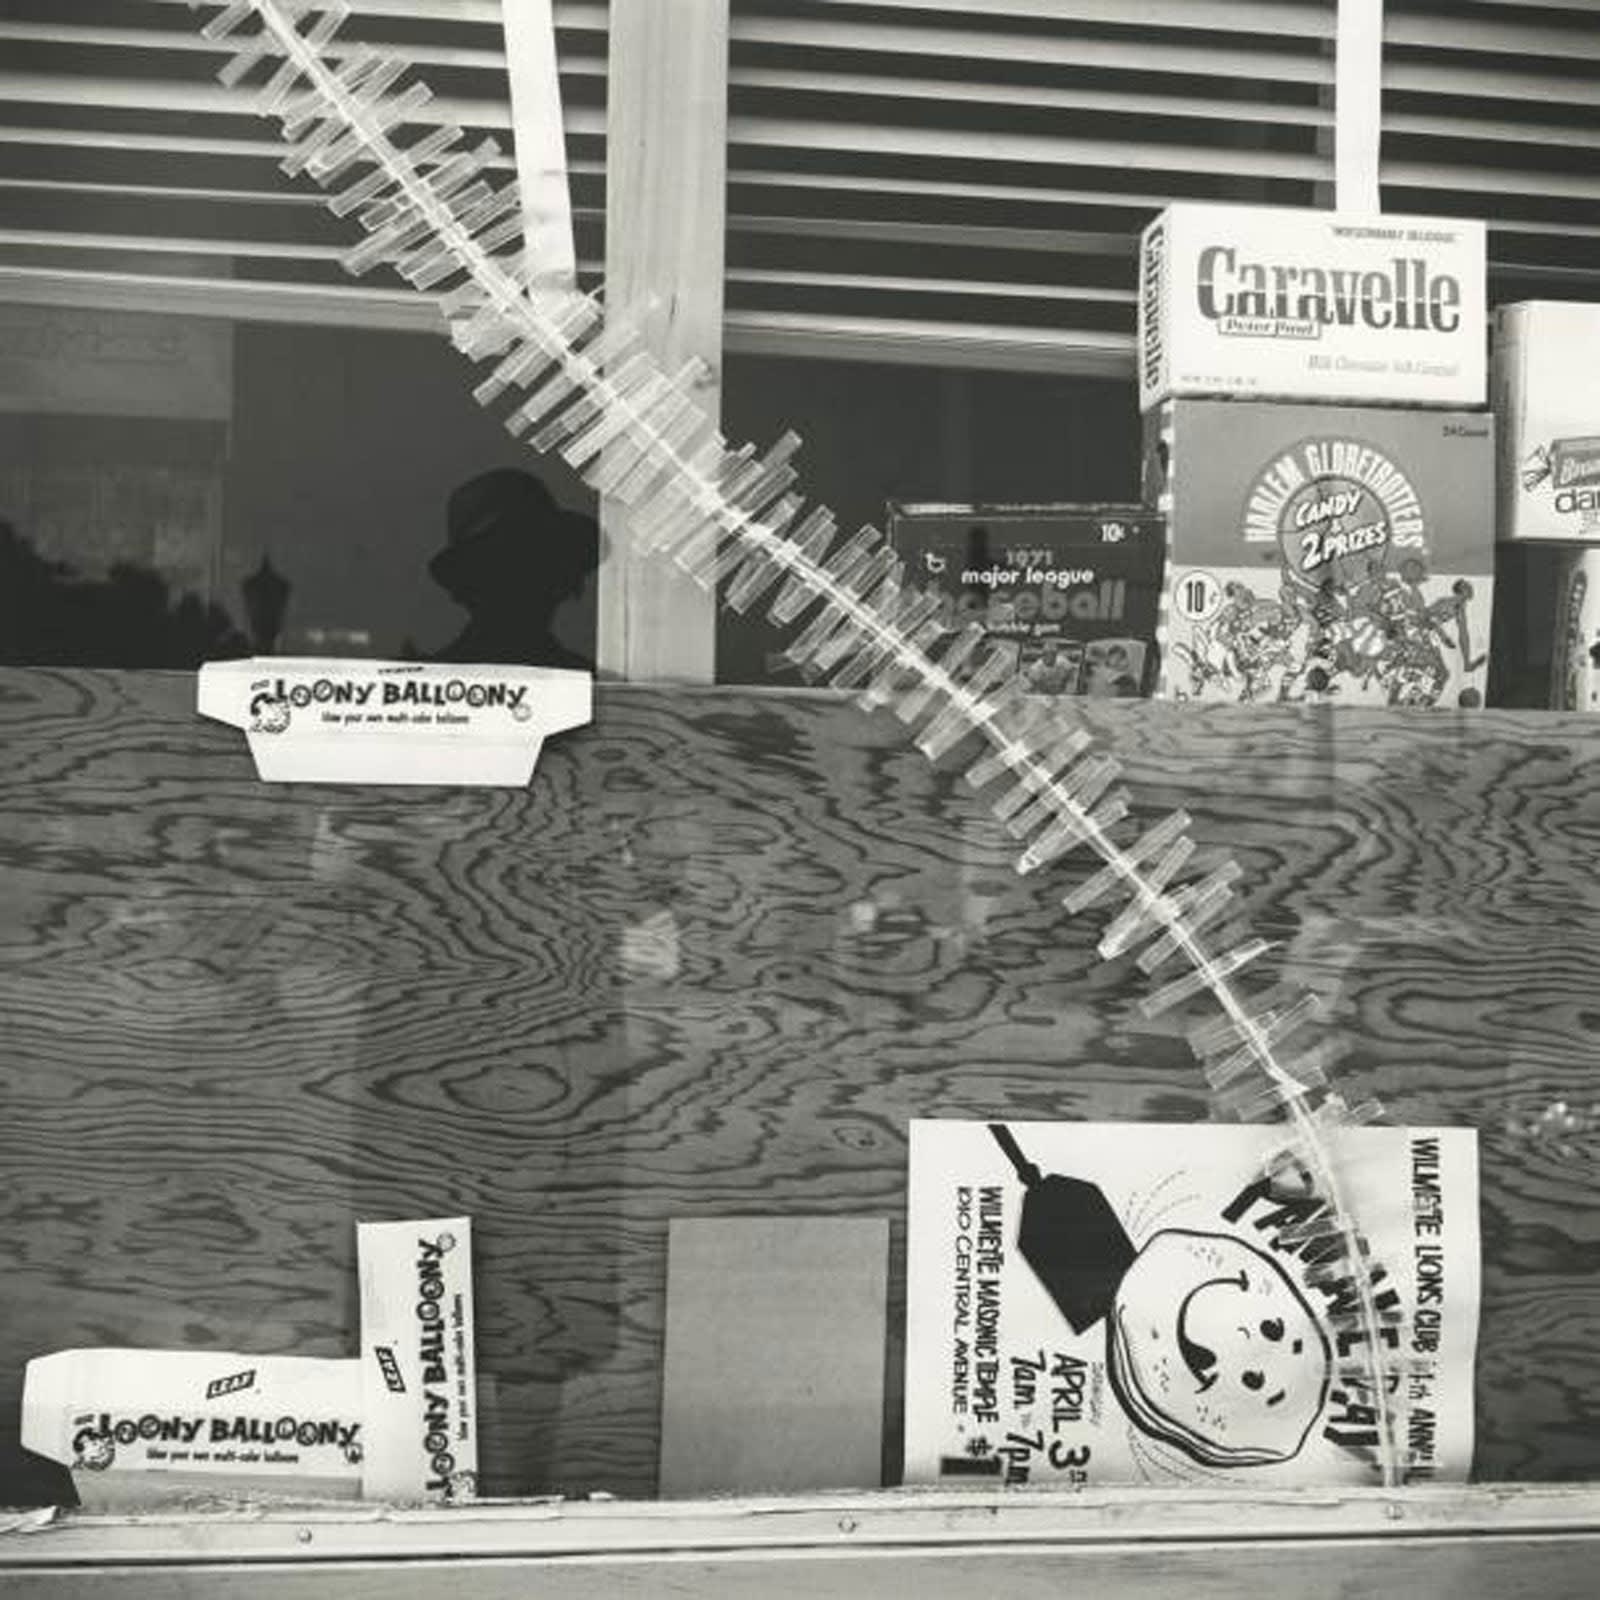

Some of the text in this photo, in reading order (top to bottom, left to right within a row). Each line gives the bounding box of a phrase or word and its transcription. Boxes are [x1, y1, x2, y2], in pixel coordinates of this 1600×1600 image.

[1197, 246, 1461, 332] Caravelle
[1244, 441, 1424, 548] HARLEM GLOBETROTTERS
[1296, 488, 1361, 527] CANDY
[961, 567, 1095, 589] major league
[1302, 521, 1387, 570] 2 PRIZES
[276, 679, 377, 707] LOONY
[382, 679, 528, 710] BALLOONY
[953, 1235, 973, 1334] CENTRAL
[972, 1186, 1004, 1423] WILMETTE MASONIC TEMPLE
[1413, 1245, 1444, 1304] LIONS
[416, 1238, 455, 1491] LOONY BALLOONY
[1411, 1309, 1442, 1353] CLUB
[953, 1338, 970, 1414] AVENUE
[1050, 1352, 1088, 1433] APRIL
[100, 1413, 206, 1444] LOONY
[209, 1416, 361, 1448] BALLOONY
